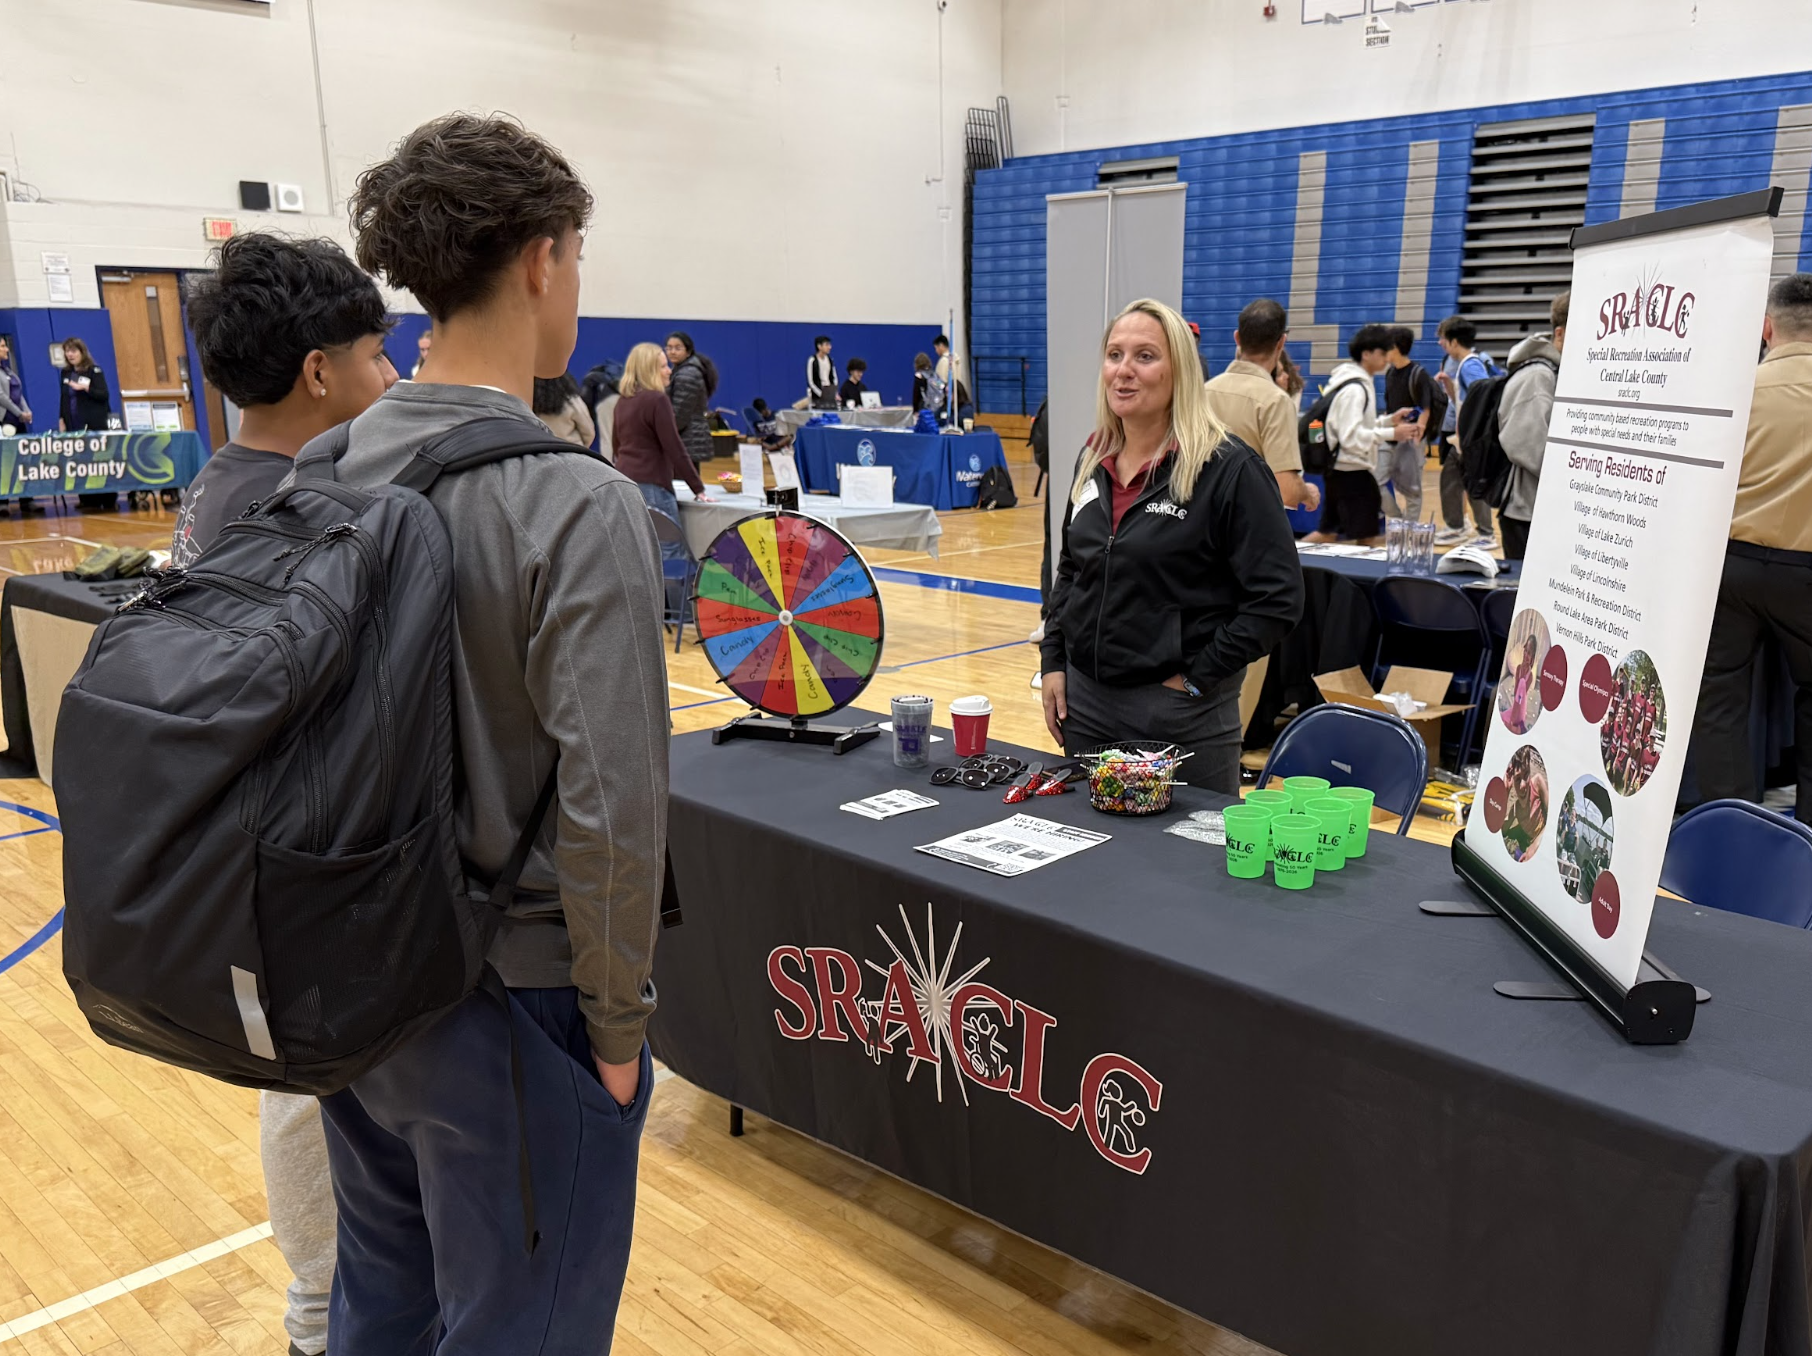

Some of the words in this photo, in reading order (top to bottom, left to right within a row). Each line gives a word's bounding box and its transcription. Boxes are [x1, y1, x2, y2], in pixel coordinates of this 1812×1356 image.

[1597, 284, 1695, 340] SRACLC
[1587, 348, 1609, 364] Special
[1610, 348, 1642, 361] Recreation
[1644, 348, 1682, 362] Association
[1682, 348, 1691, 362] of
[1600, 369, 1624, 382] Central
[1624, 370, 1640, 384] Lake
[1642, 370, 1668, 388] County
[1566, 408, 1587, 422] Providing
[1588, 412, 1615, 425] community
[1616, 414, 1630, 424] based
[1630, 416, 1657, 427] recreation
[1658, 419, 1682, 431] programs
[1682, 421, 1689, 431] to
[18, 438, 84, 457] College
[90, 436, 108, 452] of
[1571, 425, 1588, 435] people
[1589, 426, 1600, 435] with
[1601, 428, 1616, 439] special
[1617, 430, 1631, 440] needs
[1631, 432, 1642, 441] and
[1643, 432, 1657, 443] their
[1658, 433, 1677, 446] families
[18, 462, 60, 481] Lake
[65, 460, 126, 479] County
[1568, 450, 1603, 478] Serving
[1604, 456, 1653, 482] Residents
[1656, 466, 1667, 485] of
[1570, 479, 1594, 493] Grayslake
[1595, 484, 1623, 502] Community
[1624, 490, 1637, 503] Park
[1638, 493, 1658, 508] District
[1145, 502, 1188, 520] SRACLC
[1574, 500, 1591, 516] Village
[1593, 505, 1599, 516] of
[1598, 508, 1625, 523] Hawthorn
[1626, 514, 1646, 528] Woods
[1578, 523, 1594, 539] Village
[1595, 529, 1601, 539] of
[1601, 530, 1614, 543] Lake
[1614, 533, 1633, 548] Zurich
[1575, 544, 1590, 560] Village
[1591, 550, 1597, 560] of
[1597, 551, 1629, 570] Libertyville
[722, 582, 737, 594] Pen
[811, 574, 854, 601] Sunglasses
[1570, 564, 1586, 580] Village
[1586, 570, 1593, 580] of
[1592, 571, 1626, 592] Lincolnshire
[1549, 578, 1574, 595] Mundelein
[1575, 587, 1586, 601] Park
[1586, 592, 1590, 602] &
[1591, 594, 1622, 614] Recreation
[1622, 605, 1642, 622] District
[716, 614, 760, 625] Sunglasses
[1553, 600, 1569, 615] Round
[1570, 605, 1581, 620] Lake
[1581, 612, 1593, 626] Area
[1594, 617, 1607, 631] Park
[1608, 622, 1629, 640] District
[720, 636, 754, 656] Candy
[1556, 622, 1573, 638] Vernon
[1573, 629, 1584, 644] Hills
[1584, 636, 1597, 650] Park
[1597, 640, 1618, 659] District
[801, 664, 818, 699] Candy
[1582, 680, 1593, 690] Special
[1593, 683, 1609, 697] Olympics
[767, 945, 1163, 1175] SRACLC
